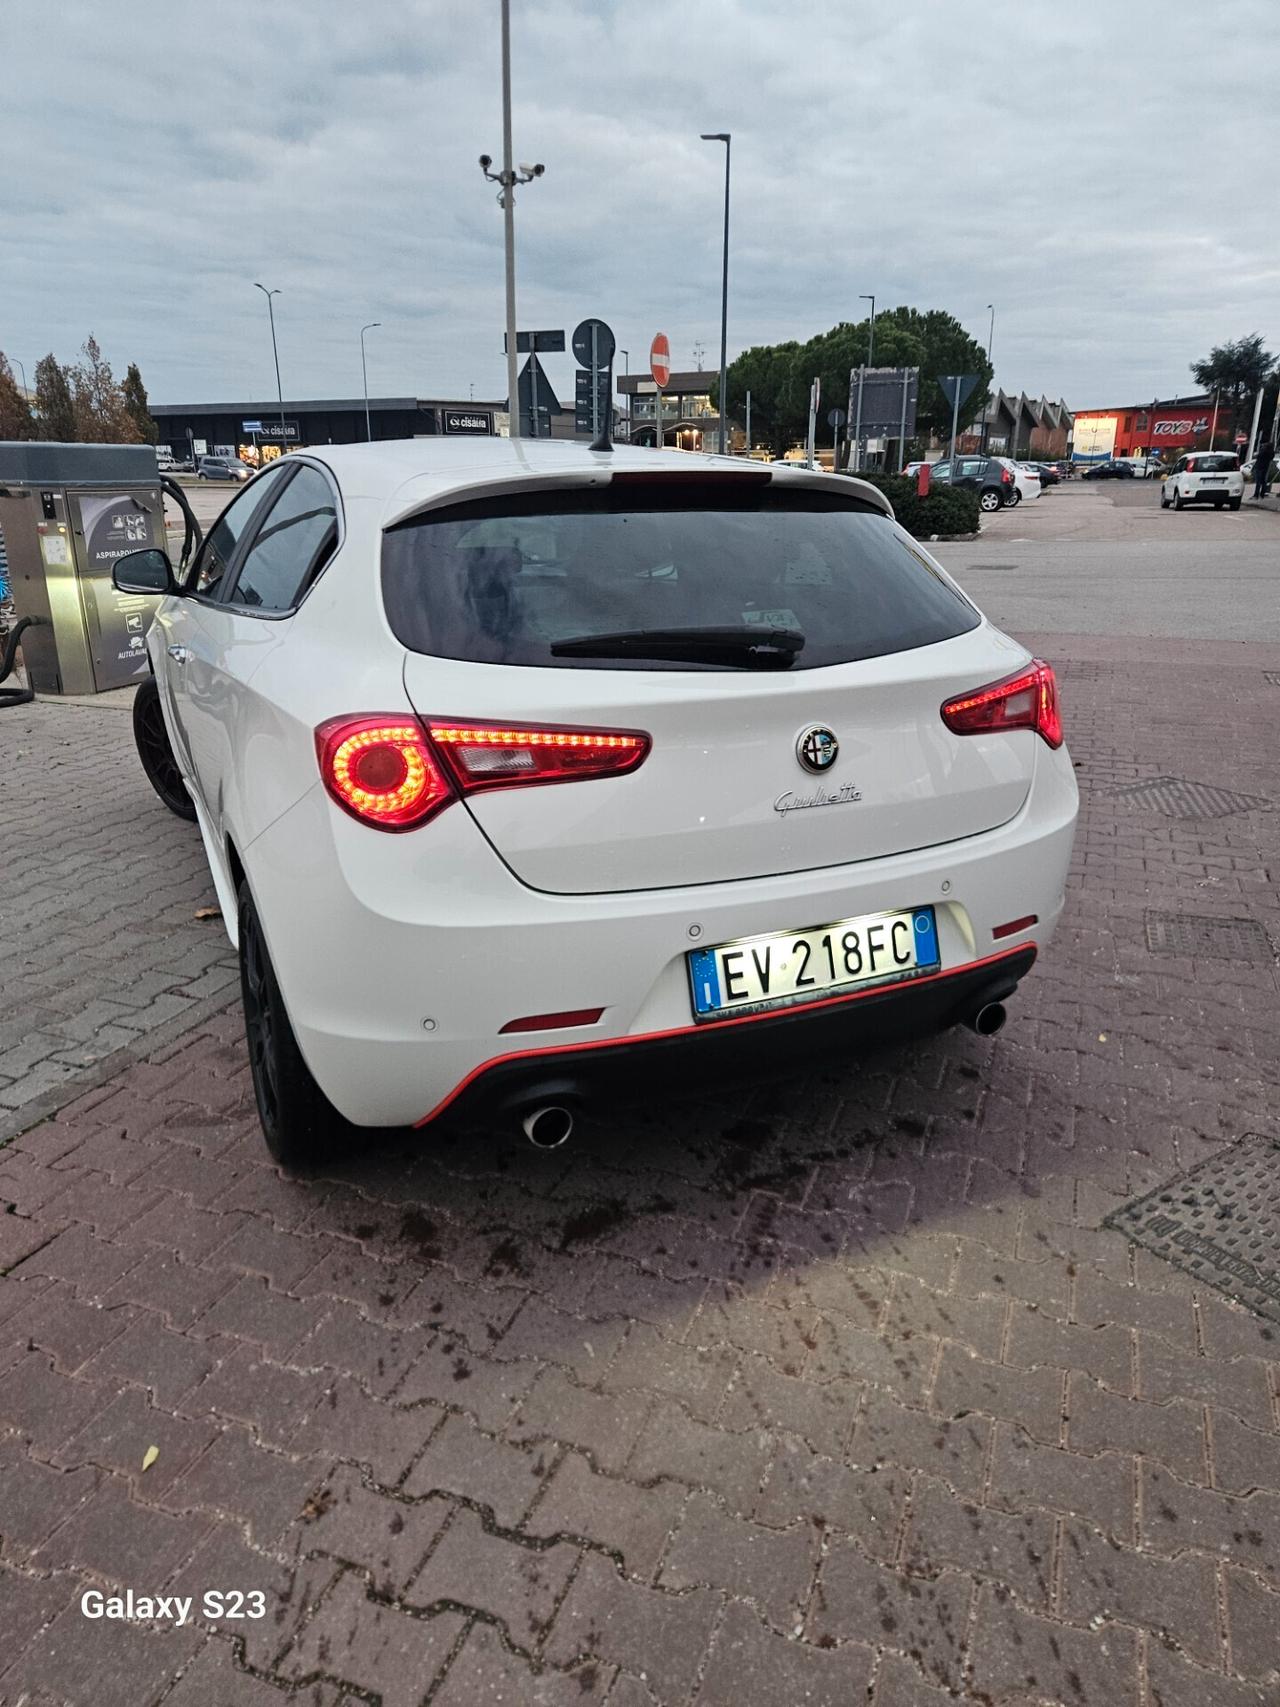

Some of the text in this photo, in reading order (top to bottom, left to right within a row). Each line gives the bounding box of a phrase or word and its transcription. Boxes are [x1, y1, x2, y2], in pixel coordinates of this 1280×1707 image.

[1154, 420, 1192, 435] TOYS
[722, 920, 911, 1000] EV 218FC
